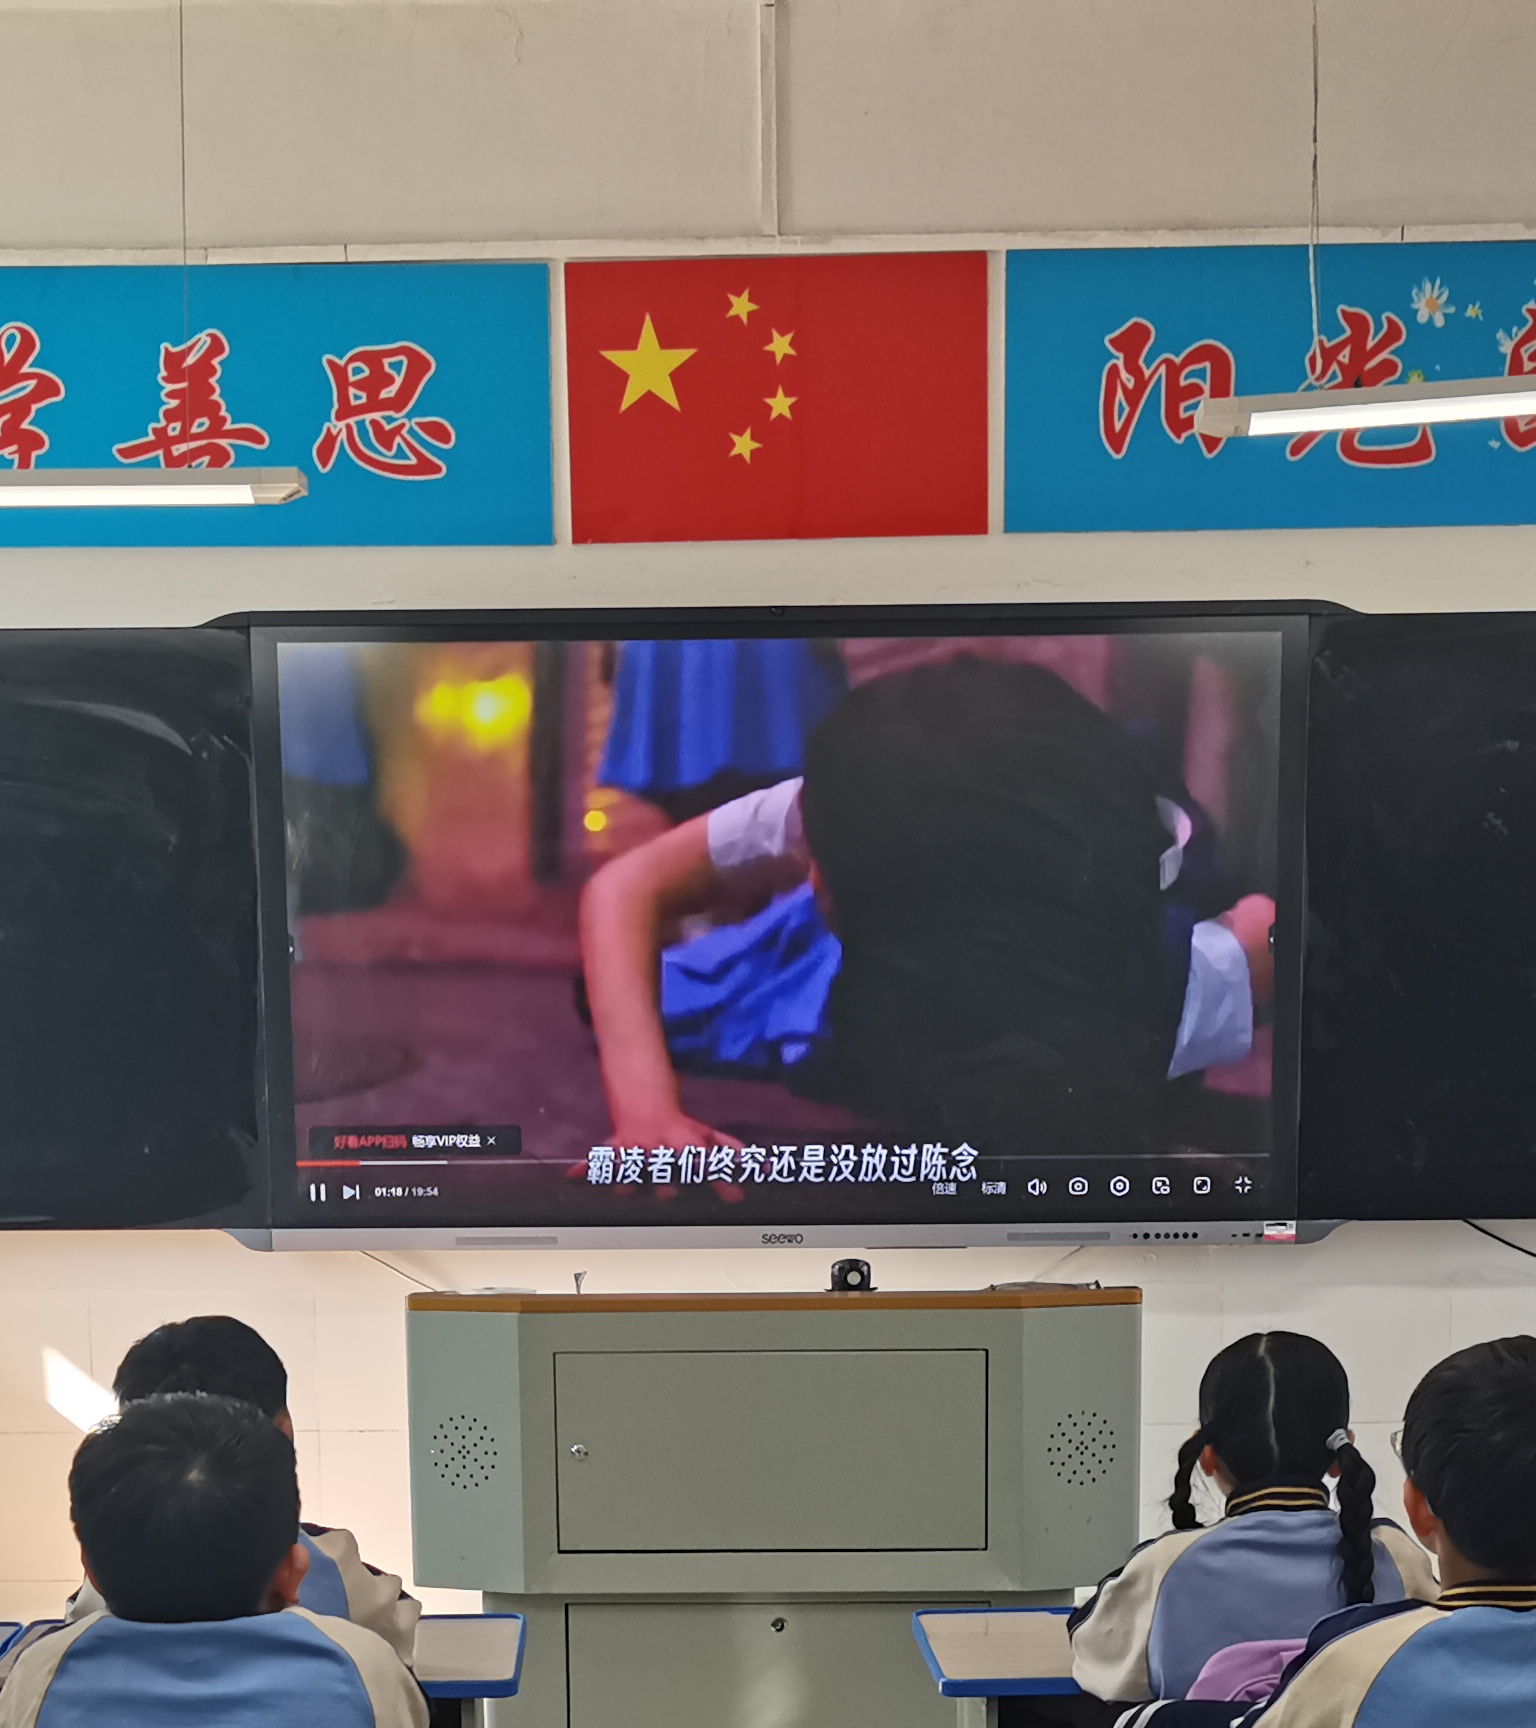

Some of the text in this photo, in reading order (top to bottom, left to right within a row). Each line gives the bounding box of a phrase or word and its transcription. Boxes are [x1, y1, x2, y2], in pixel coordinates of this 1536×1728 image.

[586, 1142, 979, 1186] 霸凌者们终究还是没放过陈念
[932, 1181, 958, 1196] 倍速
